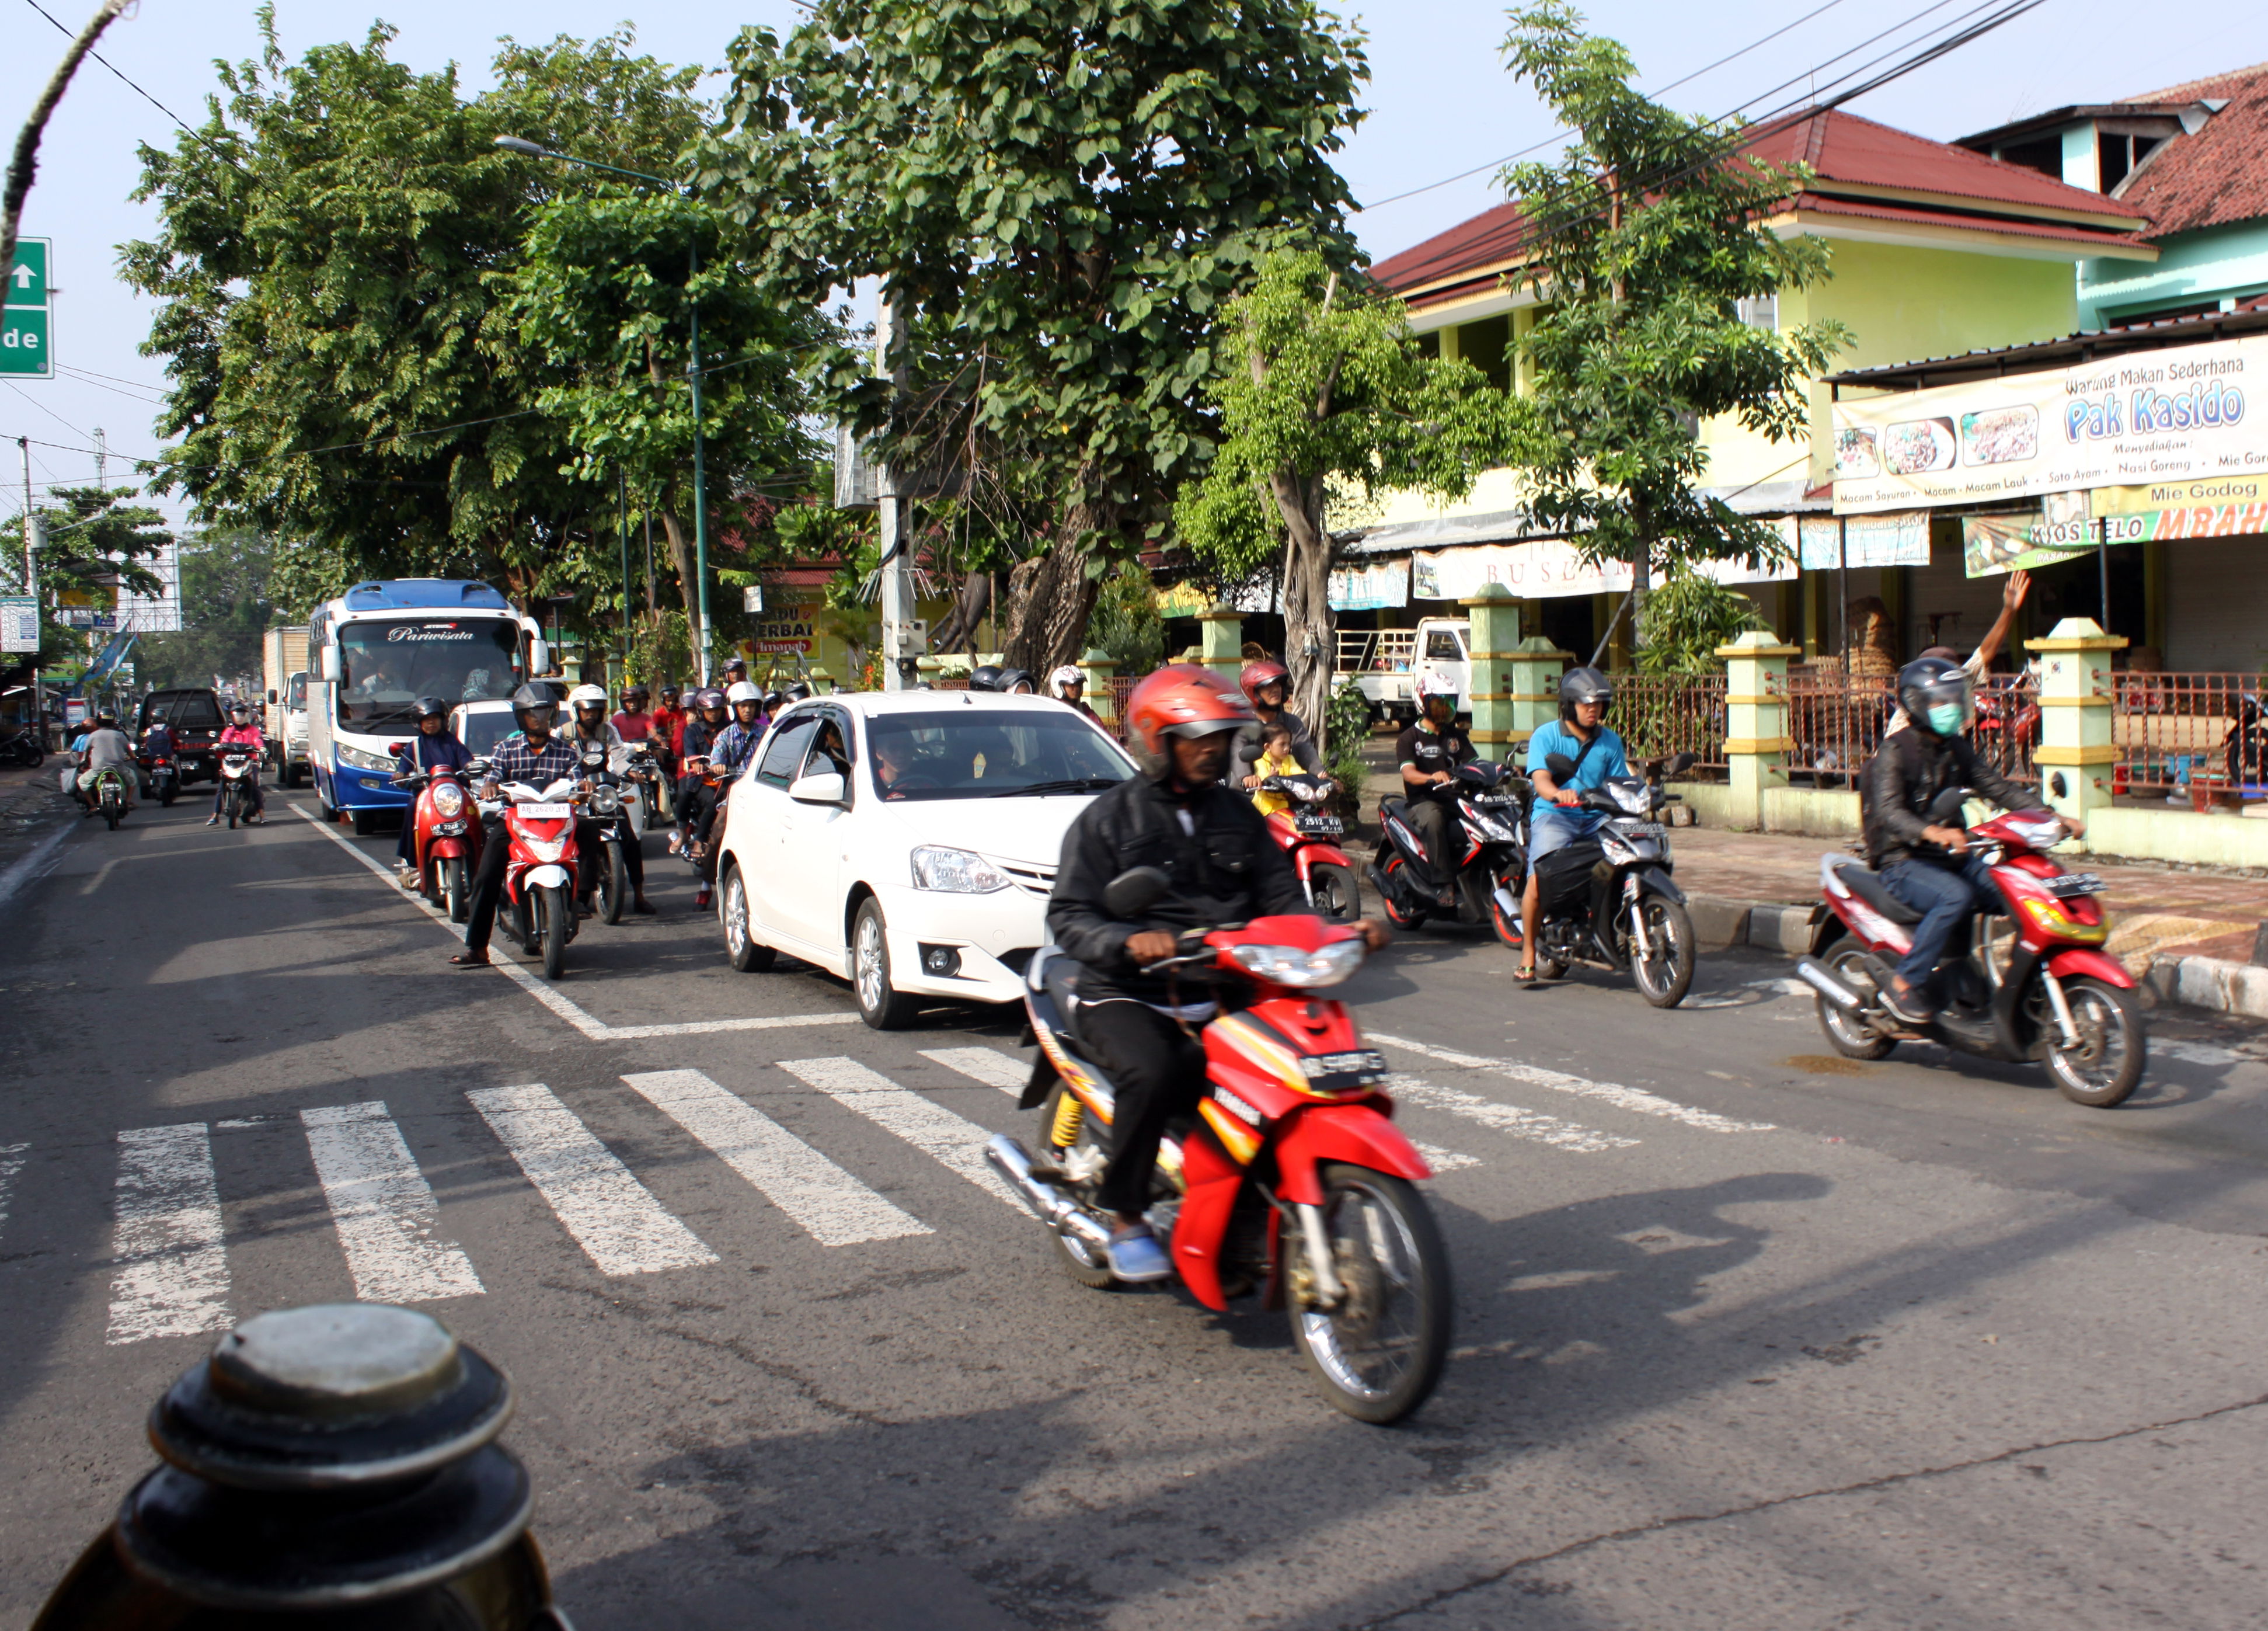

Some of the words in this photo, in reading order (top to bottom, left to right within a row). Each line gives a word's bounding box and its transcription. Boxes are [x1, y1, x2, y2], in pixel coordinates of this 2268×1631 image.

[2065, 373, 2116, 396] Warung
[2121, 368, 2164, 386] Makan
[2169, 357, 2243, 380] Sederhana
[2065, 392, 2123, 444] Pak
[2131, 379, 2245, 434] Kasido
[1840, 491, 1872, 504] Macam
[1876, 490, 1911, 502] Sayuran
[1925, 487, 1956, 497] Macam
[1966, 482, 2001, 493] Macam
[2004, 476, 2028, 489] Lauk
[2049, 471, 2070, 484] Soto
[2074, 469, 2100, 482] Ayam
[2119, 462, 2146, 474] Nasi
[2151, 458, 2191, 472] Goreng
[2218, 454, 2240, 467] Mie
[2151, 488, 2183, 502] Mie
[2189, 481, 2257, 500] Godog
[2086, 516, 2145, 543] TELO
[2152, 503, 2268, 541] MBAH
[388, 627, 475, 642] Pariwisata
